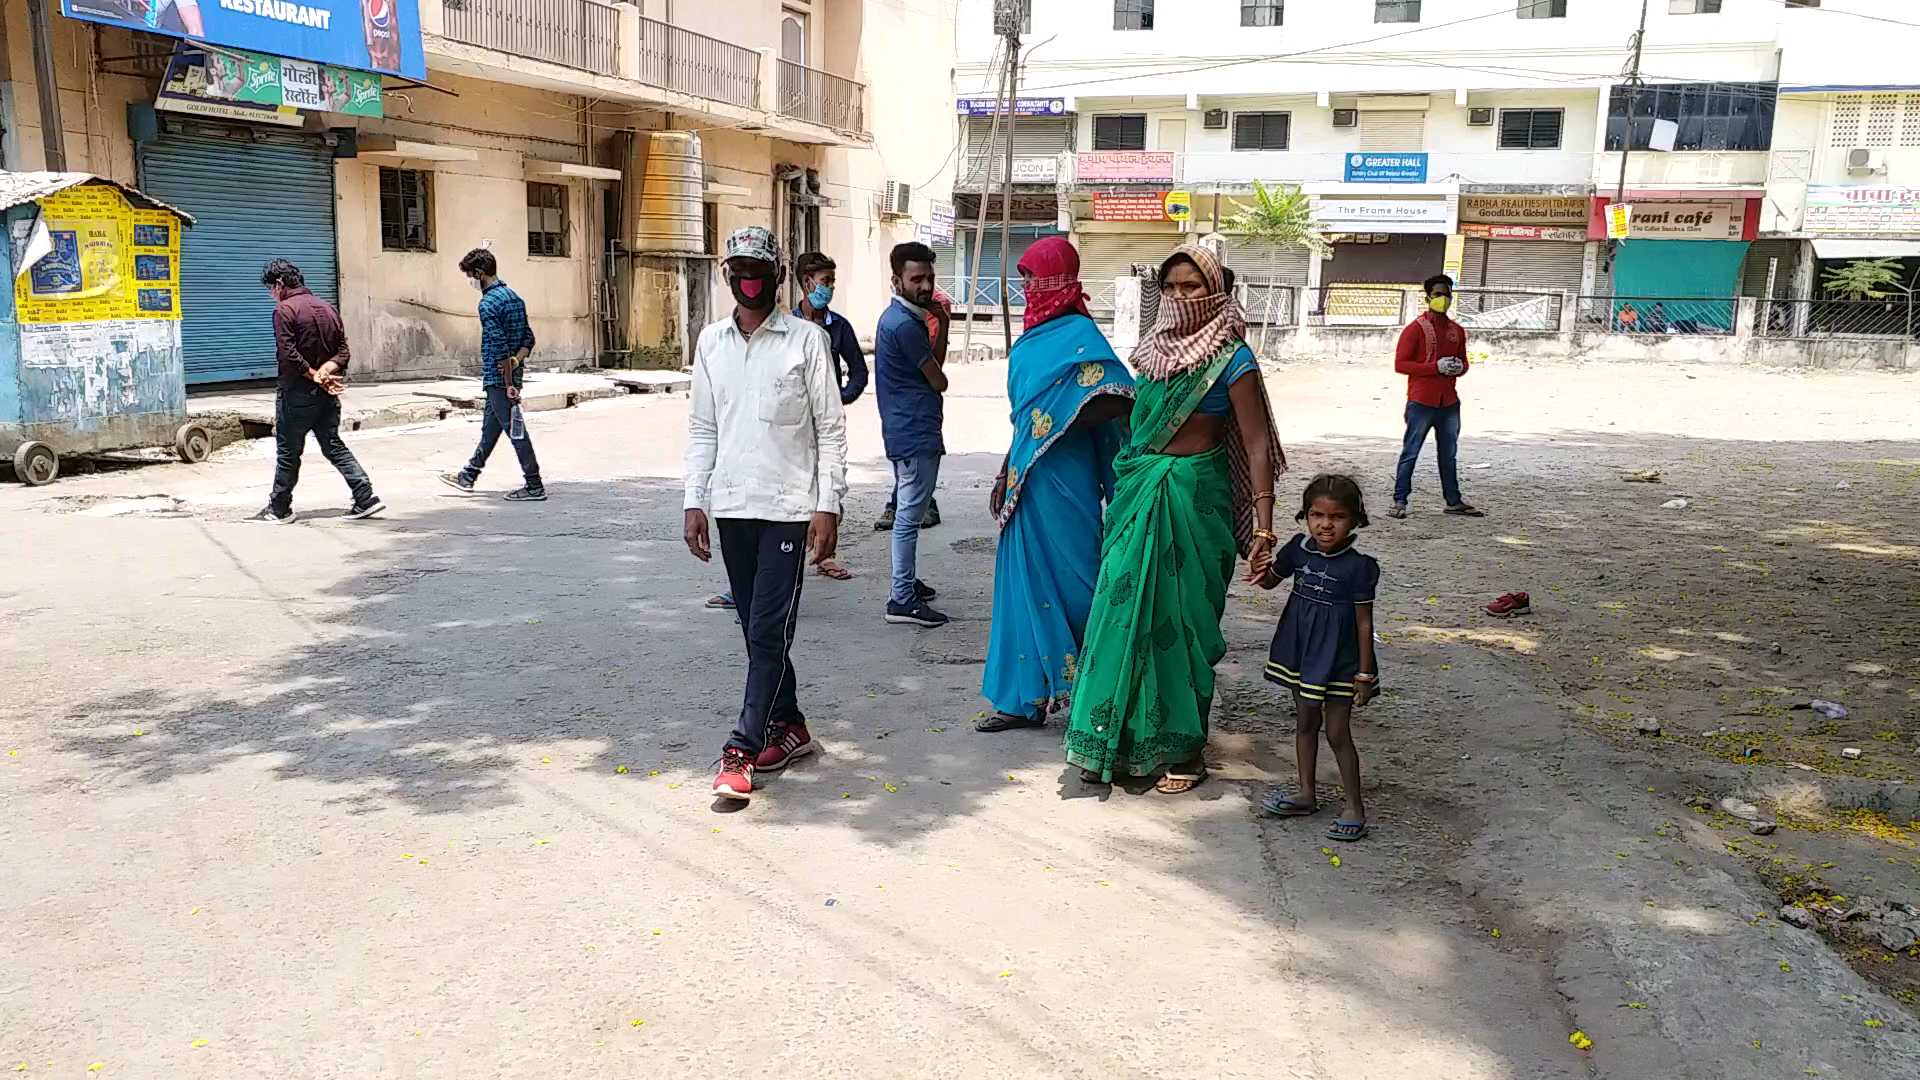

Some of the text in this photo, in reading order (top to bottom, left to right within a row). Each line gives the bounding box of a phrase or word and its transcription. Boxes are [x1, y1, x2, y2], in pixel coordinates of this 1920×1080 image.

[250, 69, 276, 88] Sprite
[282, 66, 318, 86] गोल्डी
[356, 85, 378, 102] Sprite
[1365, 157, 1421, 167] GREATER HALL
[1466, 199, 1498, 209] RADHA
[1338, 206, 1428, 215] The Frame House
[1522, 208, 1547, 218] Global
[1674, 211, 1713, 226] café
